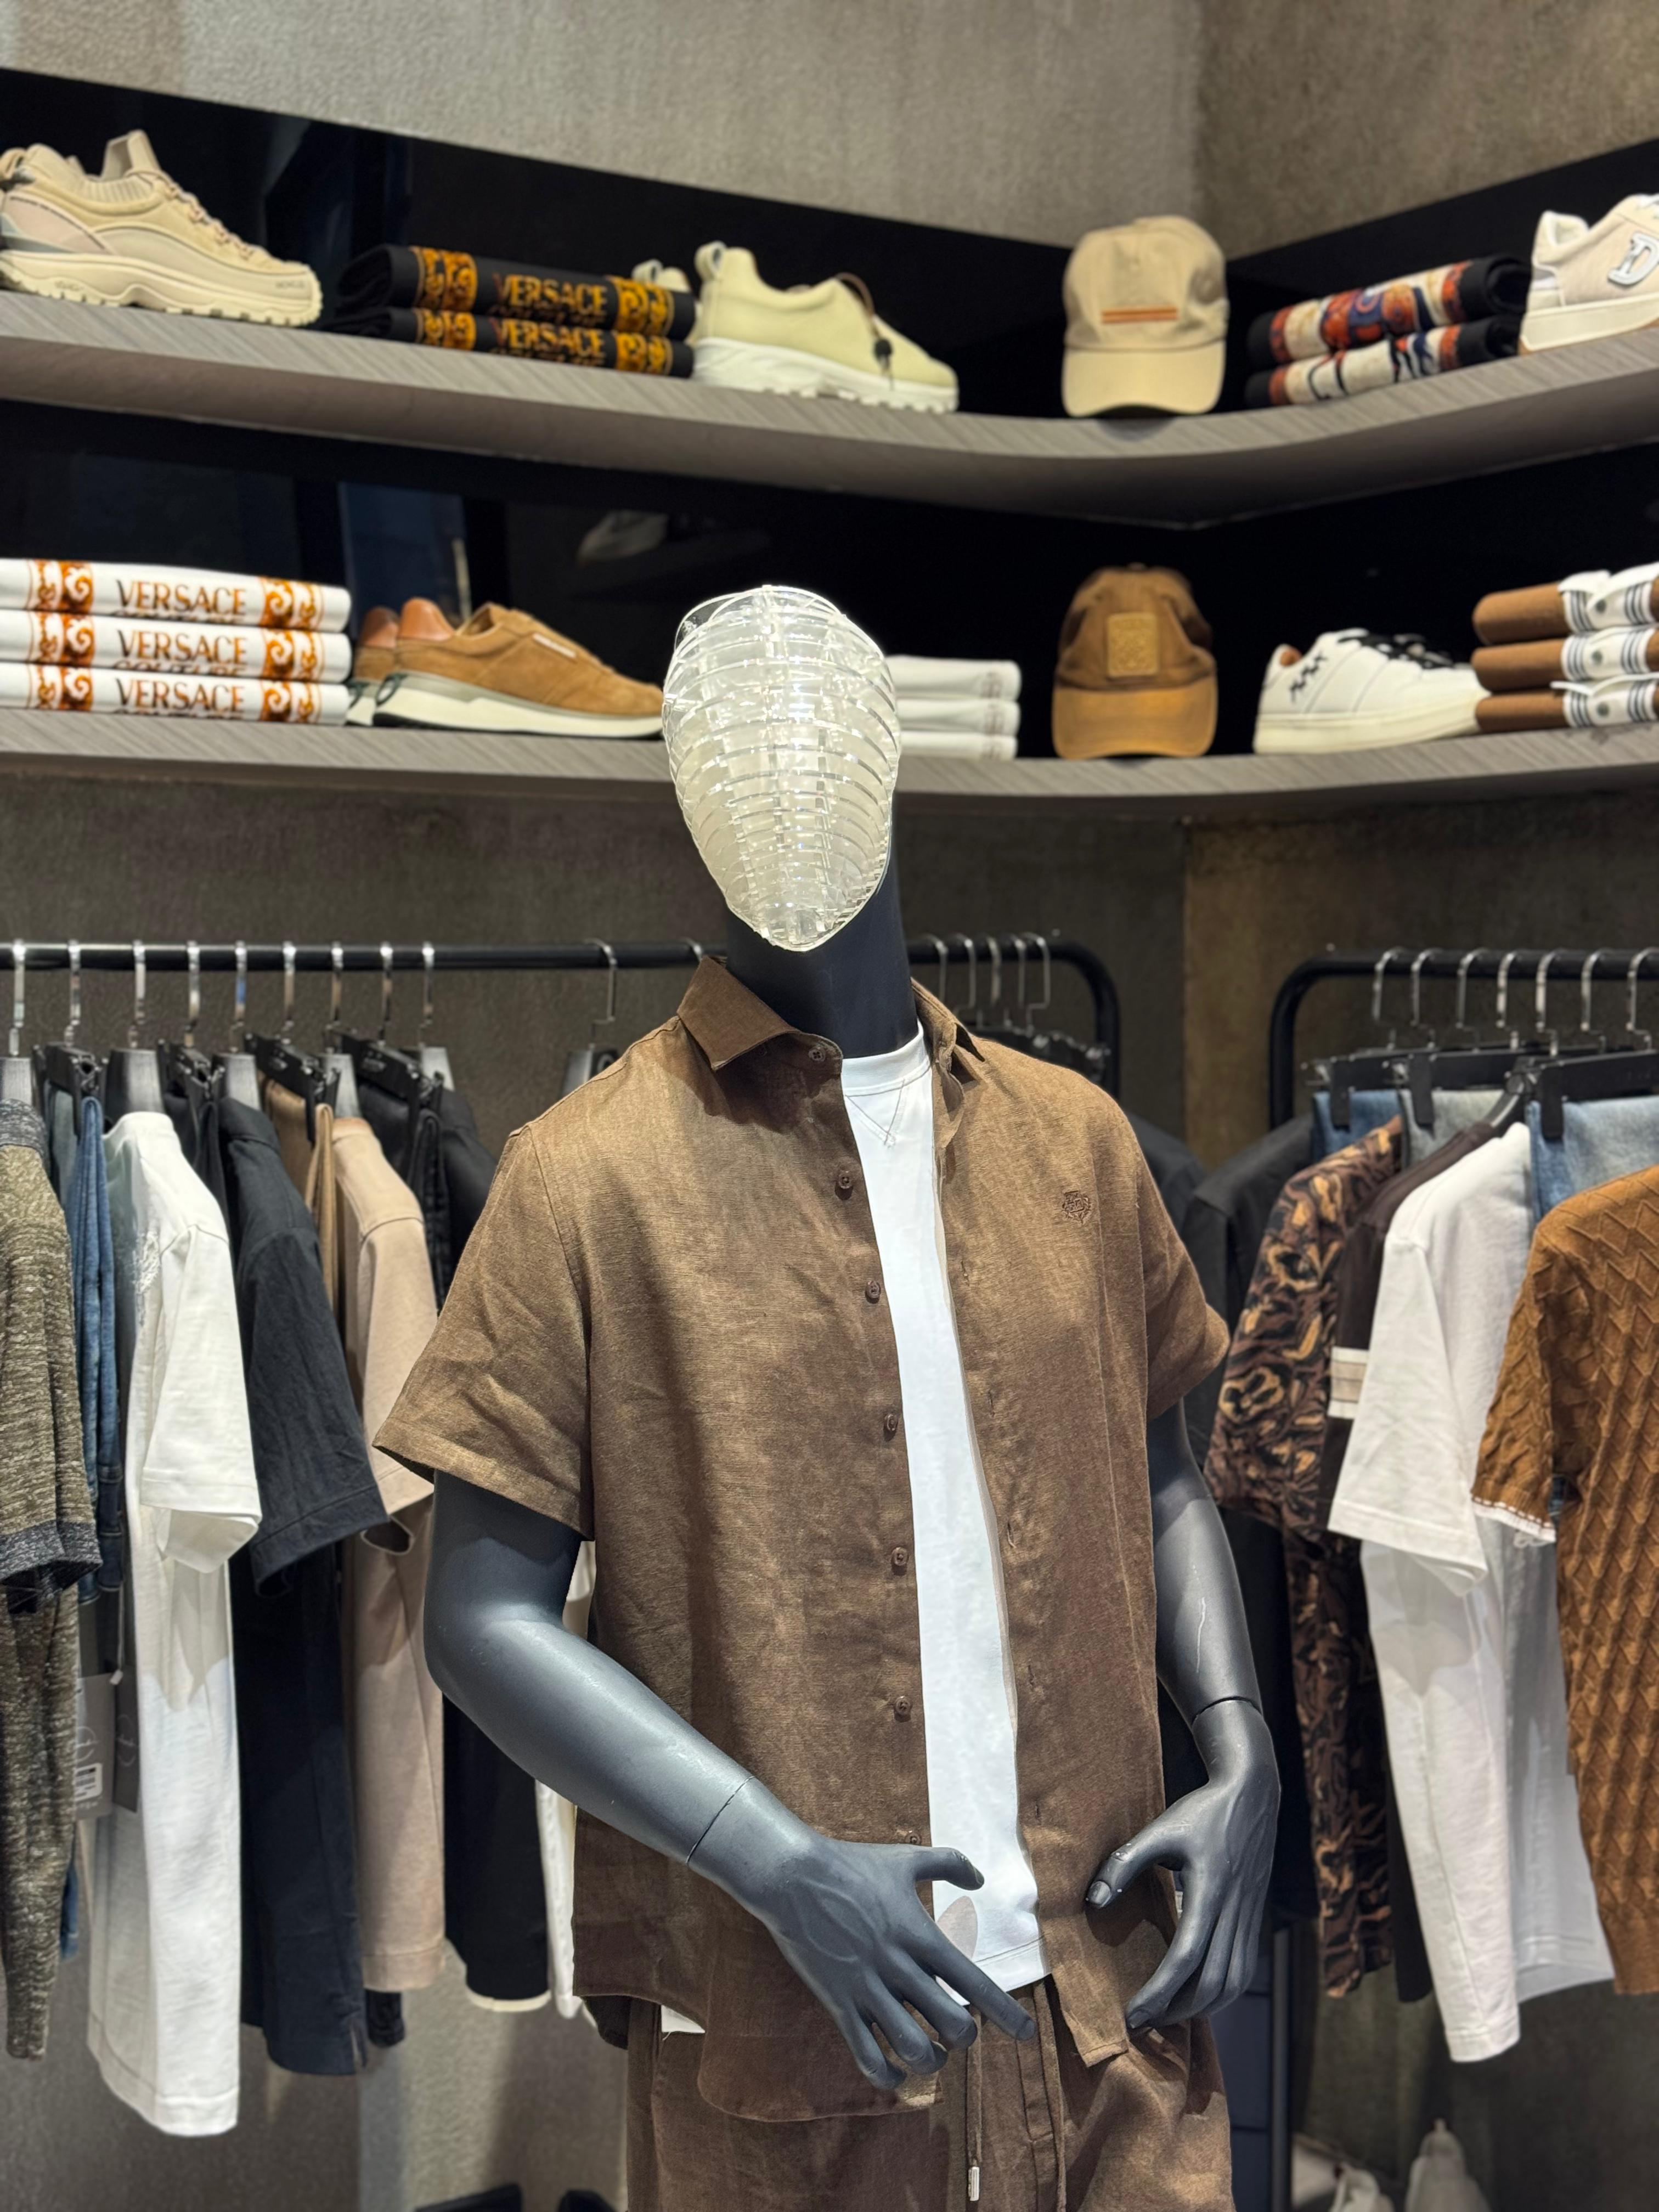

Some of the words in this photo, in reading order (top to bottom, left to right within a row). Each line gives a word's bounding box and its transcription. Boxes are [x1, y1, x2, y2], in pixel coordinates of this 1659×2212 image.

[492, 273, 607, 315] VERSACE
[489, 317, 606, 357] VERSACE
[116, 579, 246, 615] VERSACE
[116, 629, 247, 664] VERSACE
[116, 678, 245, 713] VERSACE
